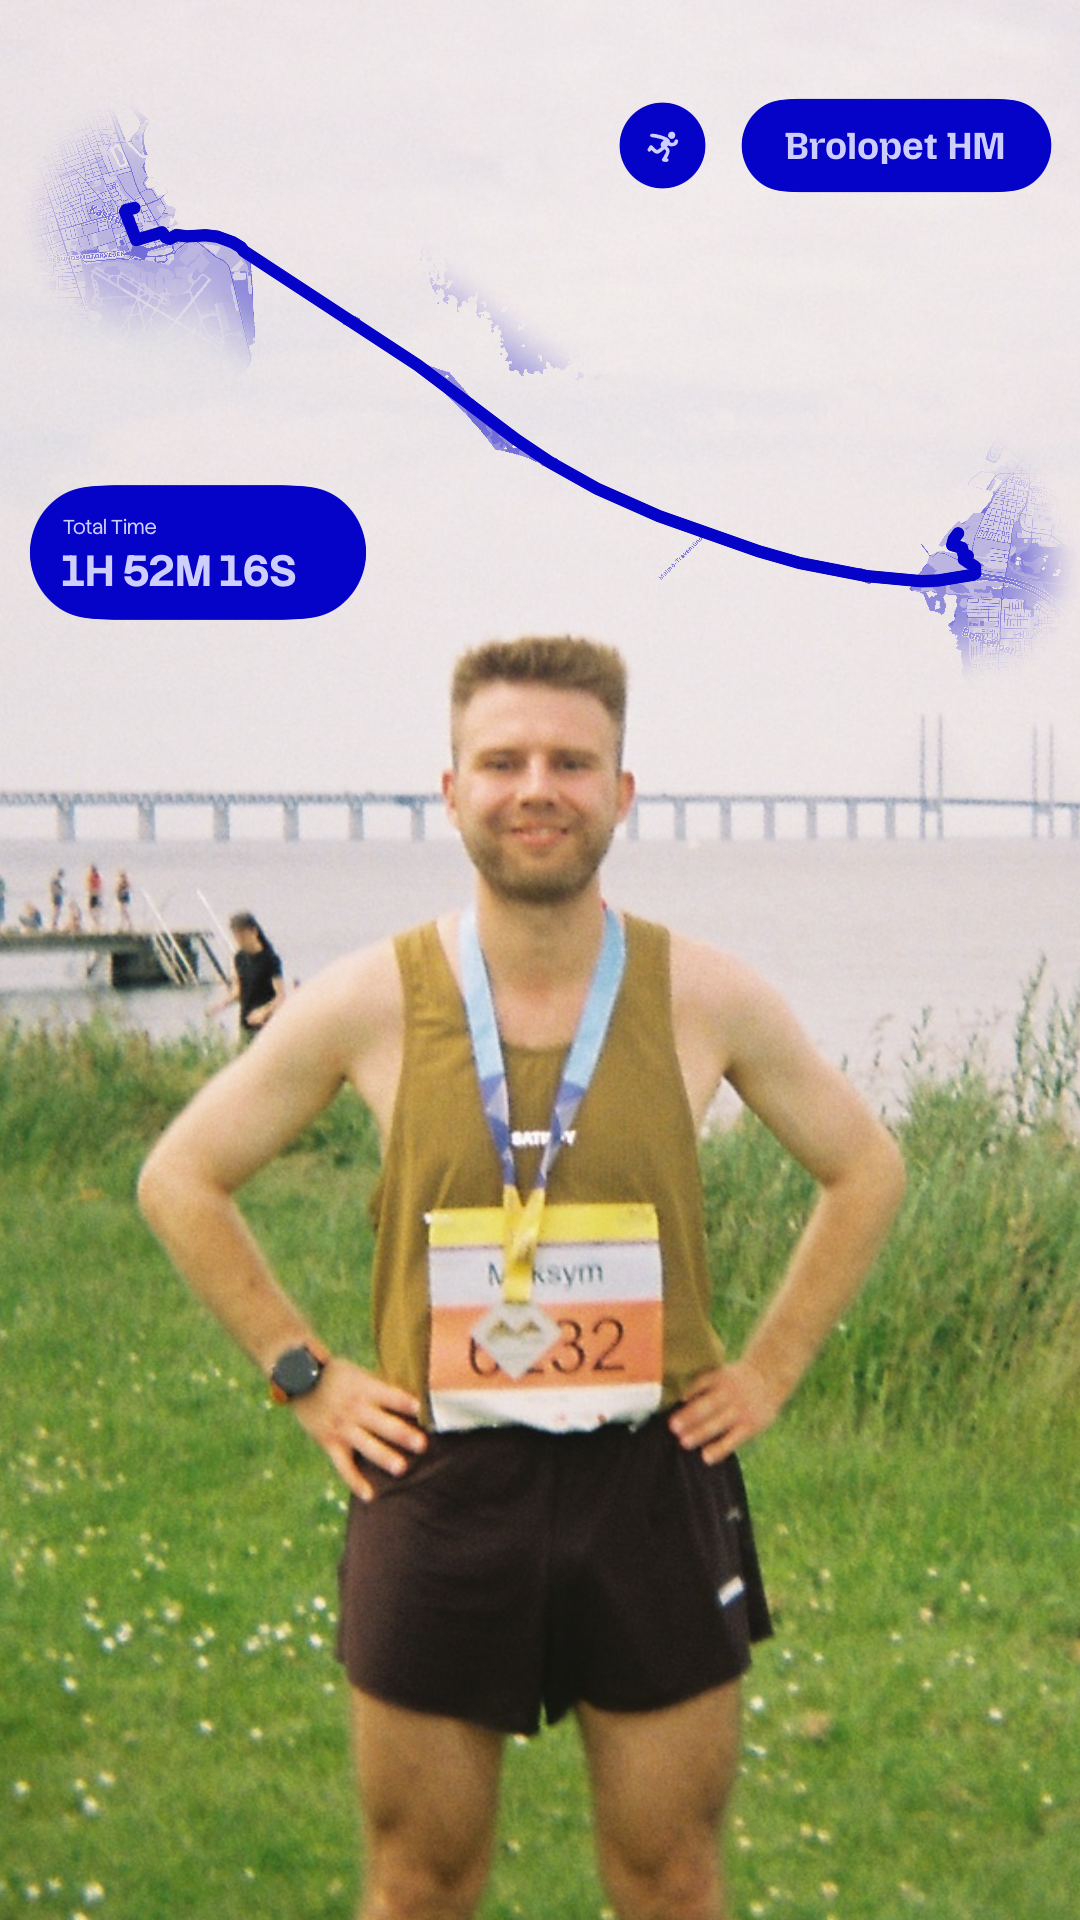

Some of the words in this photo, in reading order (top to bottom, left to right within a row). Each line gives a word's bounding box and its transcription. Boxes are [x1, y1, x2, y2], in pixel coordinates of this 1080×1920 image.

[511, 1130, 577, 1146] SATIY
[487, 1260, 604, 1291] Mksym
[467, 1316, 626, 1376] 32
